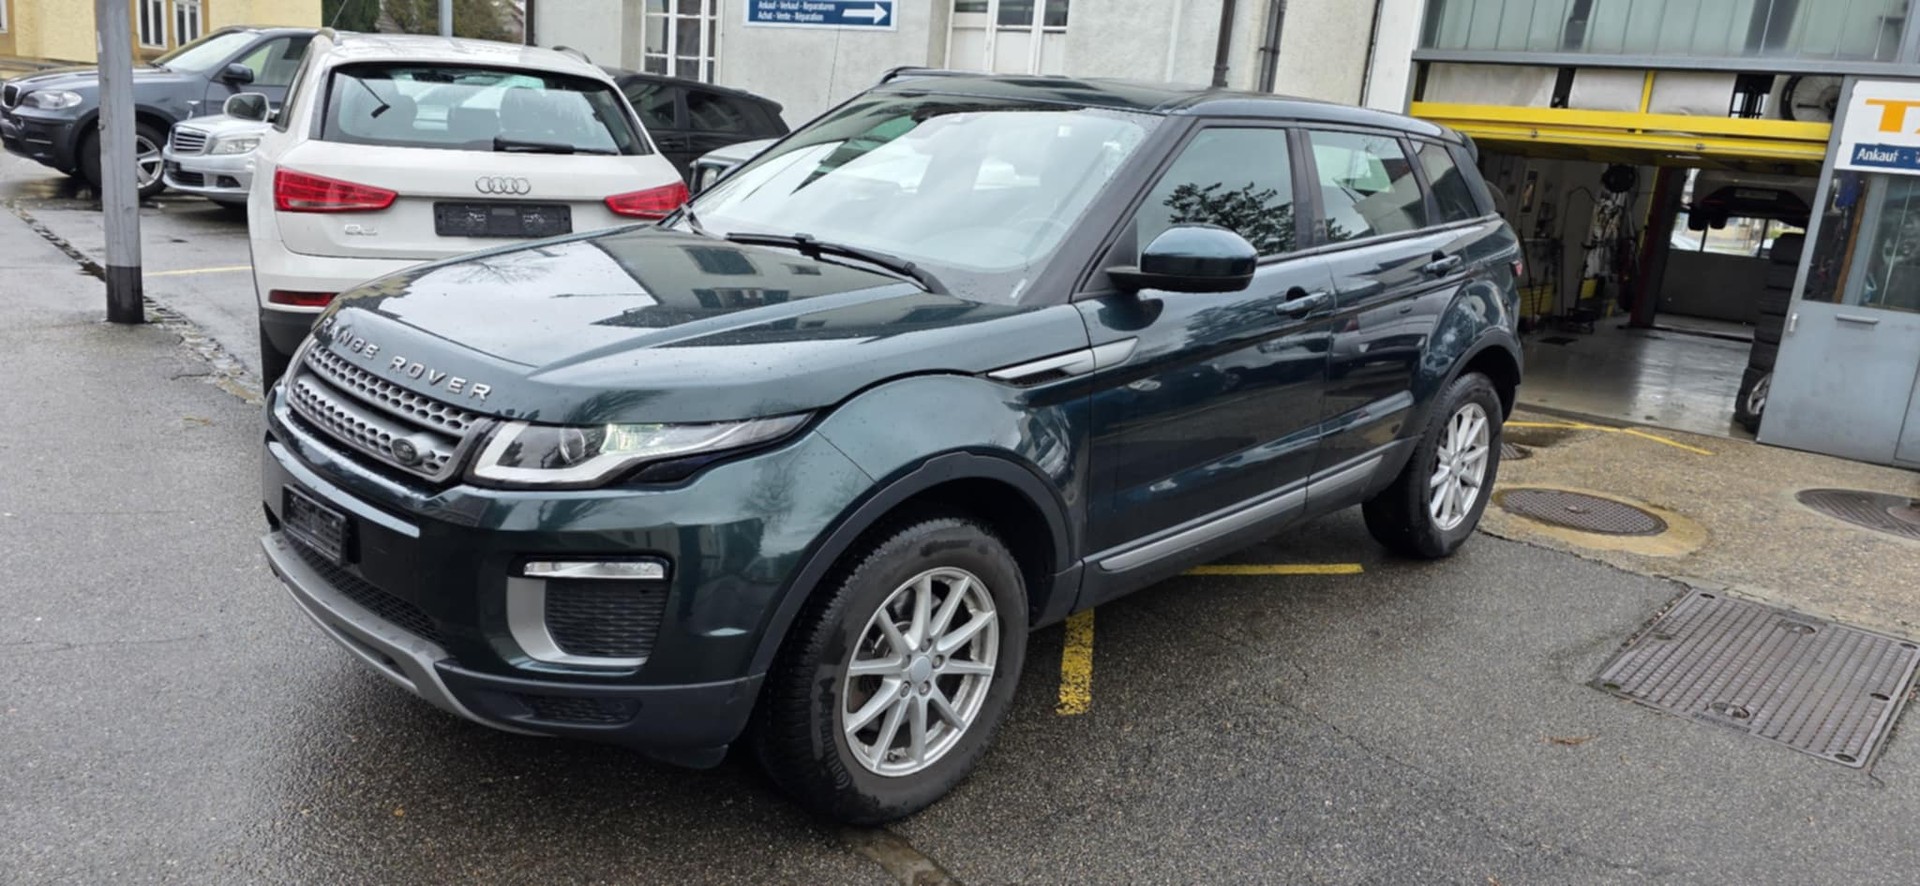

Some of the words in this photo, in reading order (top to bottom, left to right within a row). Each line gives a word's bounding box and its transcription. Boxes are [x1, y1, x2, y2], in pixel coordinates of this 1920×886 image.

[1865, 98, 1920, 133] T
[1856, 147, 1899, 163] Ankauf
[322, 317, 380, 360] RANGE
[389, 355, 492, 401] ROVER
